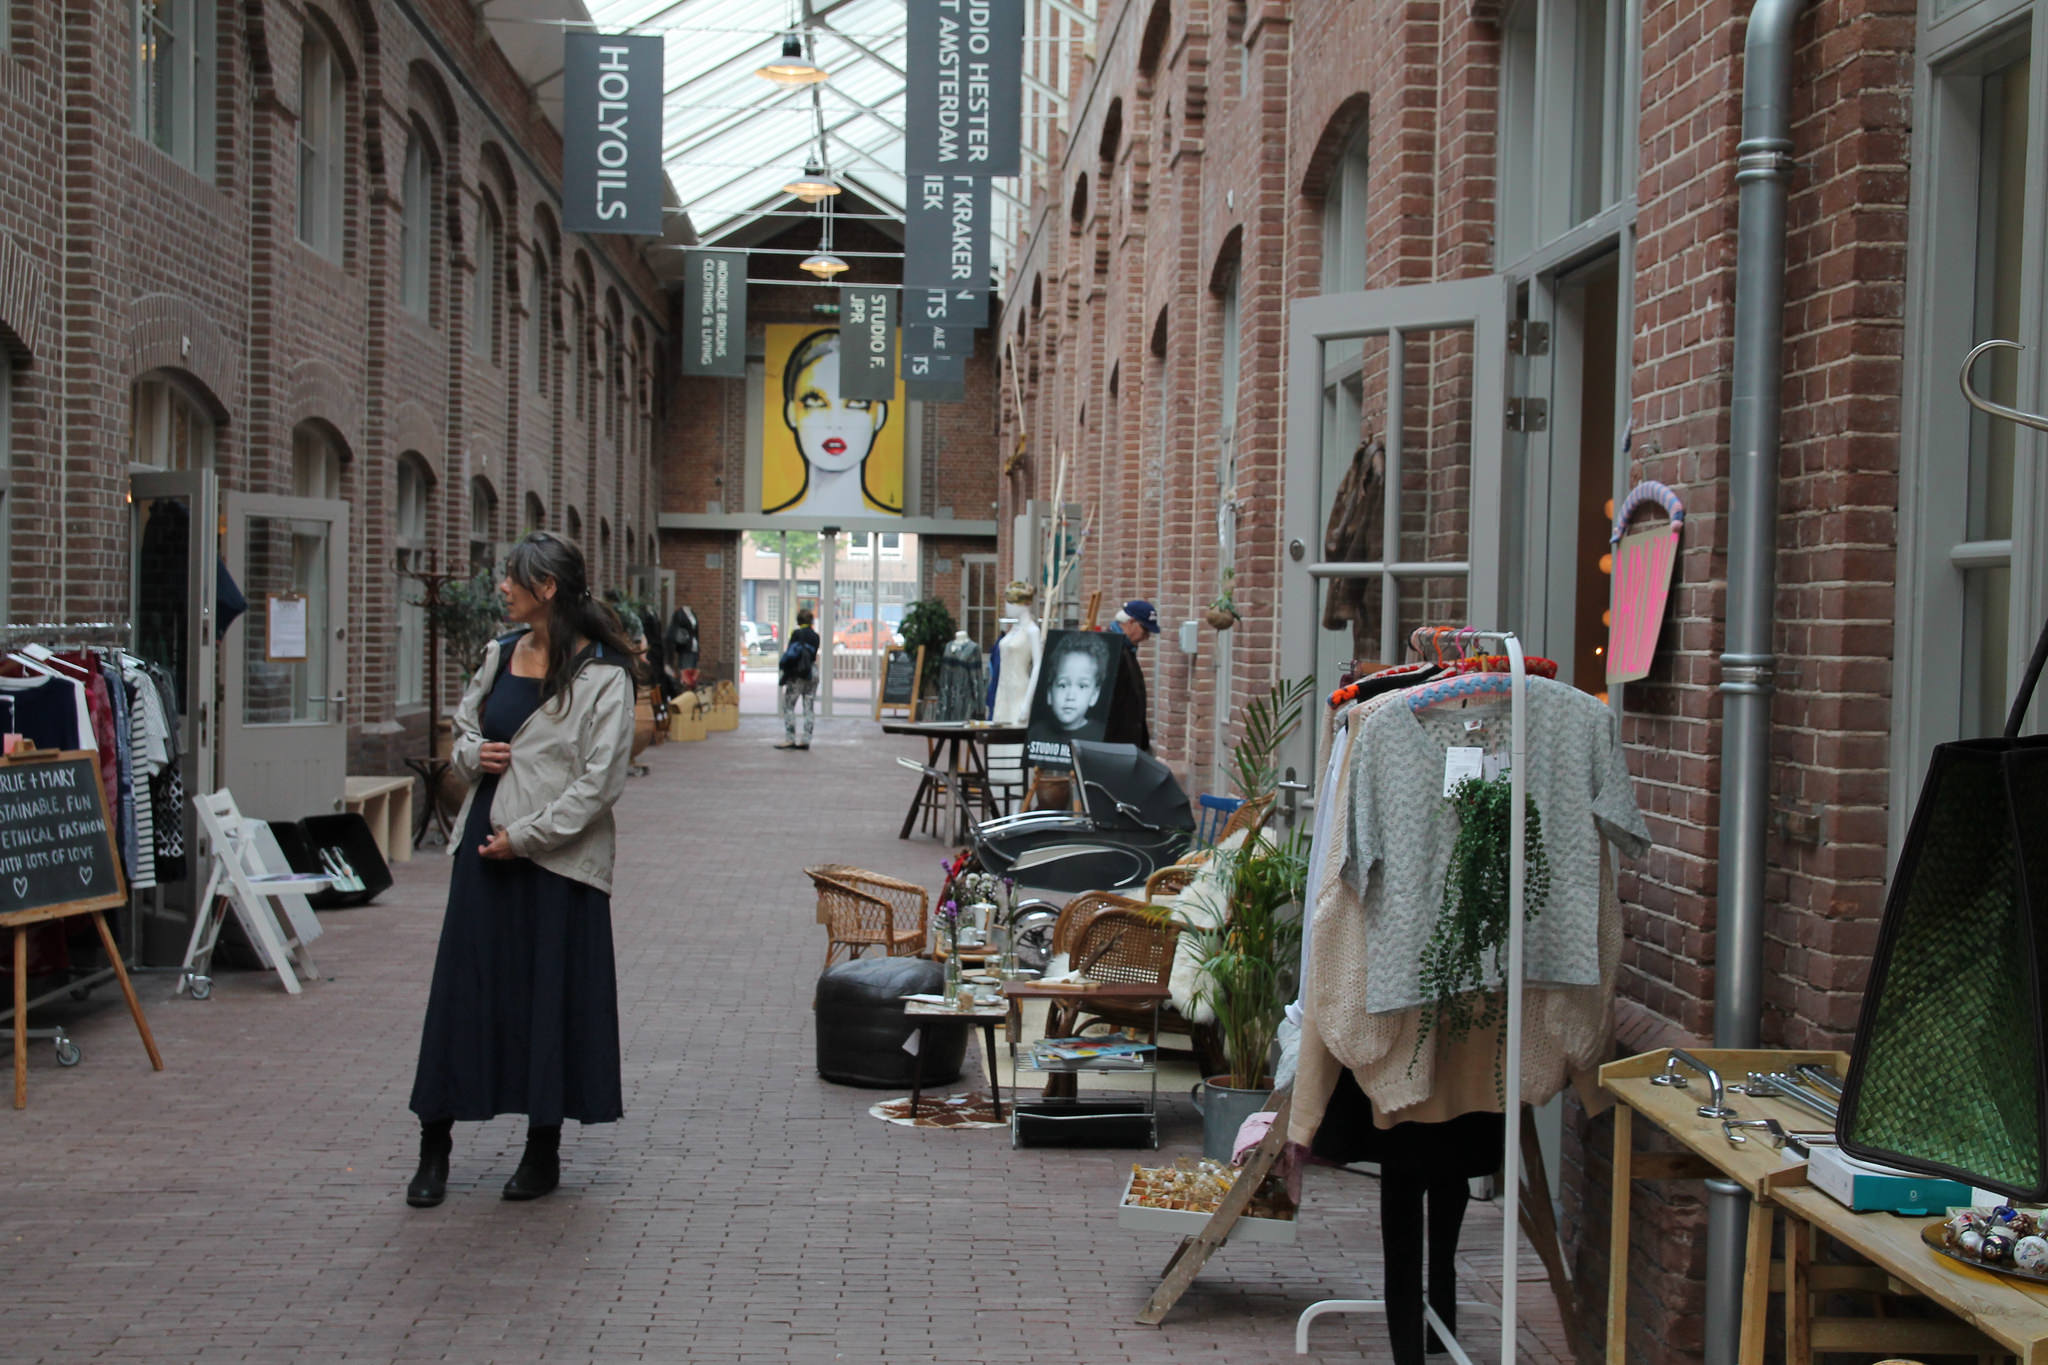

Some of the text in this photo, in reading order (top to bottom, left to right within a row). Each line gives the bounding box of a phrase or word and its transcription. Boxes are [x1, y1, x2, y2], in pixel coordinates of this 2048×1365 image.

[938, 16, 960, 162] AMSTERDAM
[596, 46, 629, 220] HOLYOILS
[968, 63, 990, 162] HESTER
[952, 193, 973, 280] KRAKER
[702, 258, 715, 315] CLOTHING
[715, 260, 728, 313] MONIQUE
[850, 293, 866, 324] JPR
[701, 328, 713, 365] LIVING
[869, 294, 887, 368] STUDIO F.
[1030, 741, 1060, 755] STUDIO
[40, 767, 76, 789] MARY
[67, 795, 92, 813] FUN
[1, 818, 107, 849] ETHICAL FASHION
[25, 851, 50, 870] LOTS
[51, 847, 65, 865] OF
[67, 845, 94, 863] LOVE
